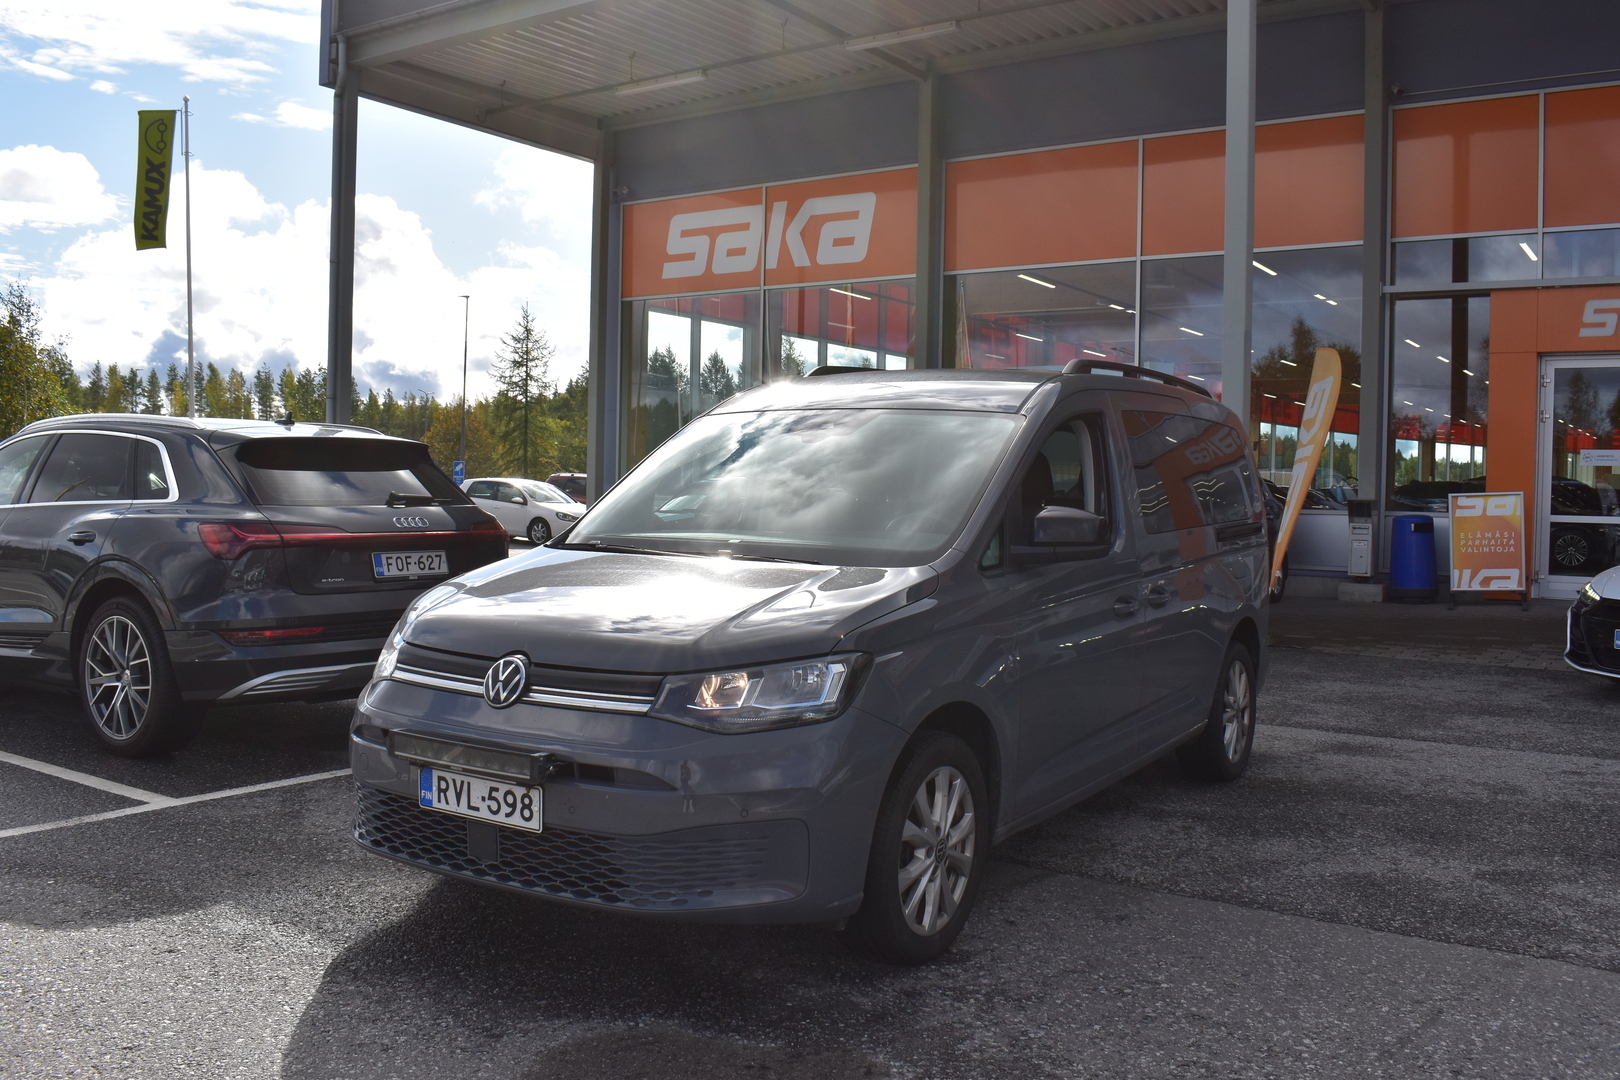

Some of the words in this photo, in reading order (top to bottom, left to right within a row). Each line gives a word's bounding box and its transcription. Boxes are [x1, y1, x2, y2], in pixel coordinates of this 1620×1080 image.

[140, 156, 167, 241] KAMUX
[1460, 530, 1515, 539] ELÄMÄSI
[385, 554, 442, 573] FOF-627
[421, 790, 433, 800] FIN
[436, 775, 534, 822] RVL-598
